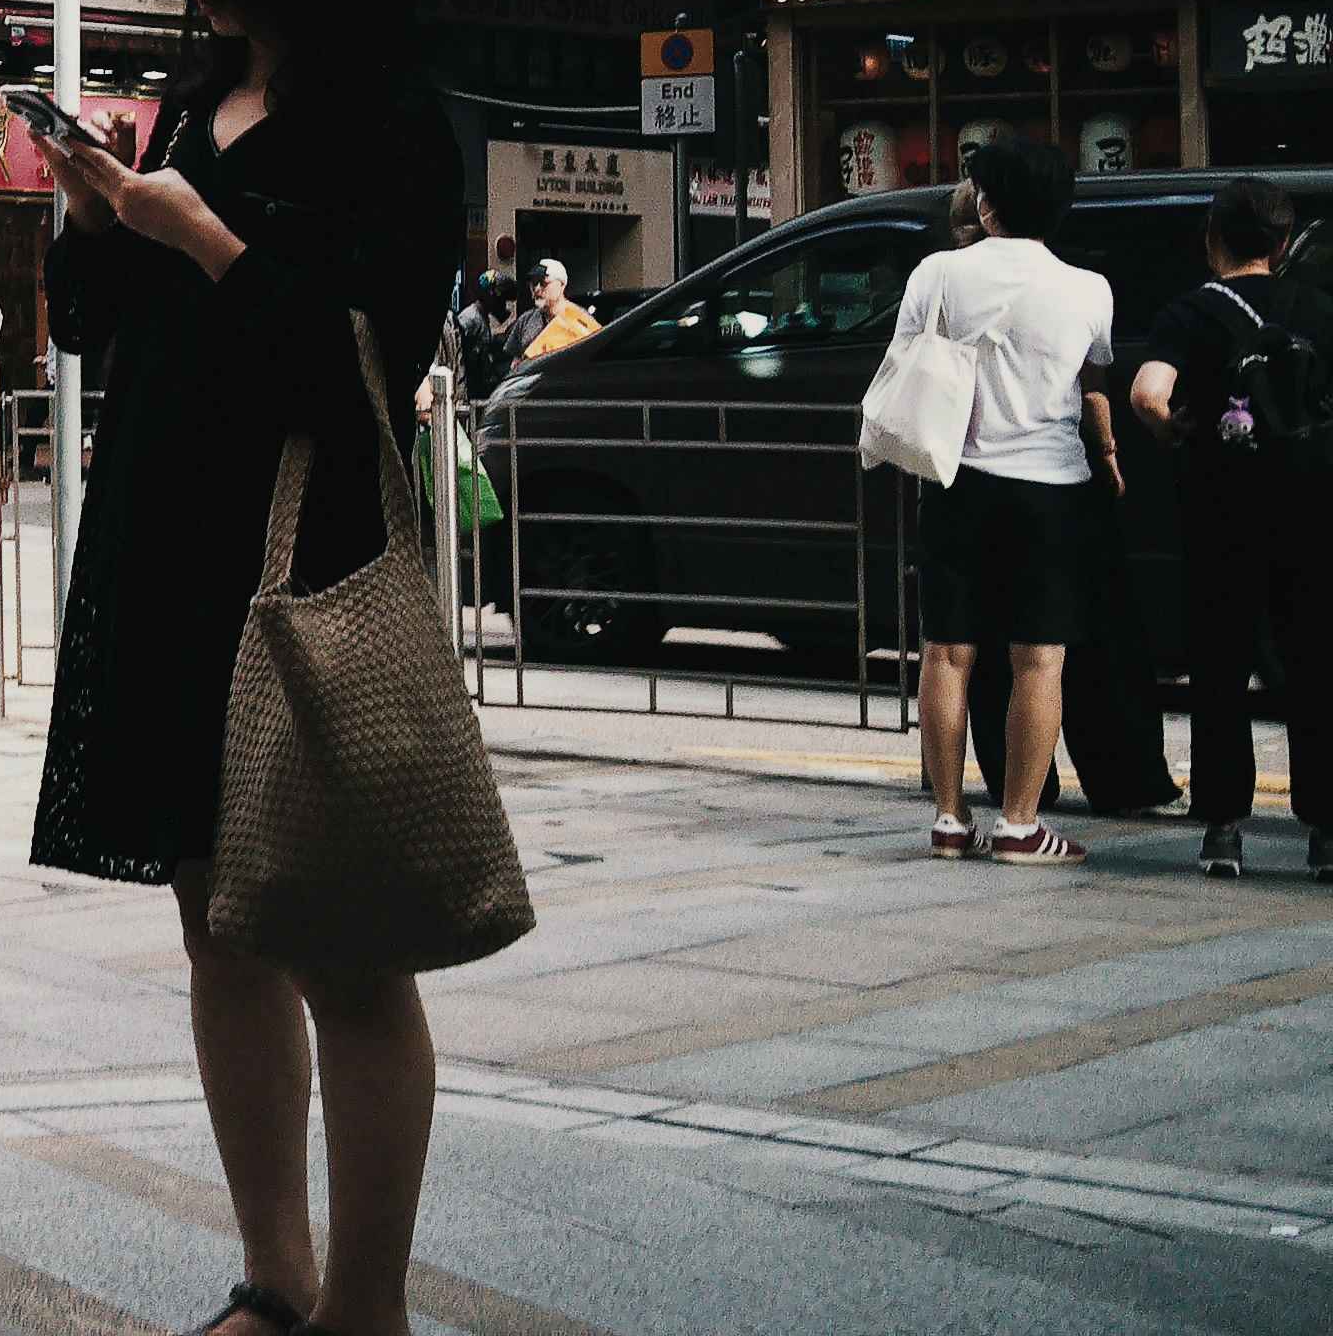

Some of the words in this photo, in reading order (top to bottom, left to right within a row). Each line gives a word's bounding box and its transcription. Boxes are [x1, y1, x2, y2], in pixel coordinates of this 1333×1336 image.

[661, 83, 694, 100] End
[654, 104, 702, 129] 終止
[575, 179, 624, 195] BUILDING
